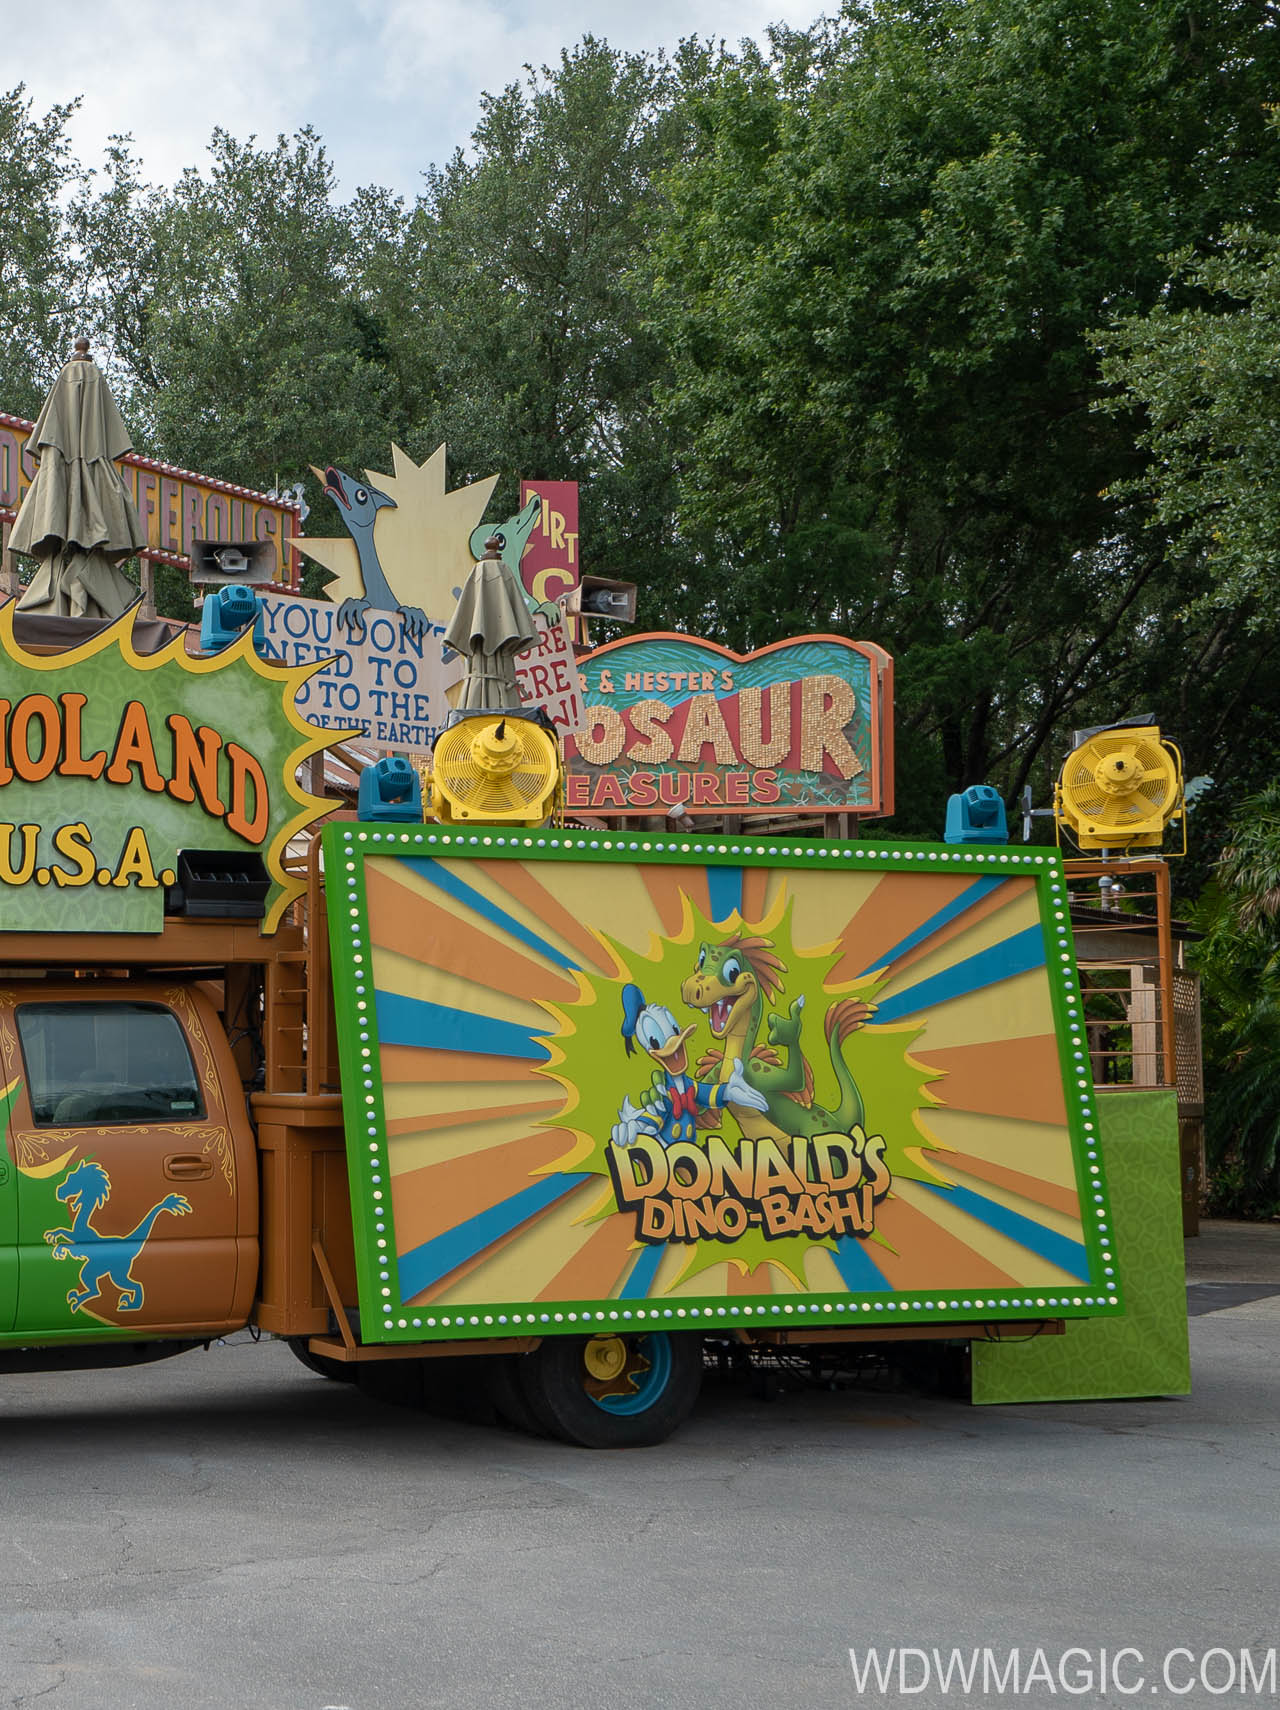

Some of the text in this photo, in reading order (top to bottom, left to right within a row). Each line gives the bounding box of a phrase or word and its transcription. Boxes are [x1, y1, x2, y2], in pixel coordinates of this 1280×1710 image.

[263, 598, 333, 643] YOU
[263, 637, 417, 689] NEED TO
[514, 659, 571, 702] ERE
[599, 669, 615, 693] &
[624, 669, 734, 692] HESTER'S
[295, 681, 429, 721] O TO THE
[377, 722, 437, 746] EARTH
[566, 769, 781, 807] EASURES
[608, 1124, 892, 1203] DONALD'S
[641, 1184, 875, 1240] DINO-BASH!
